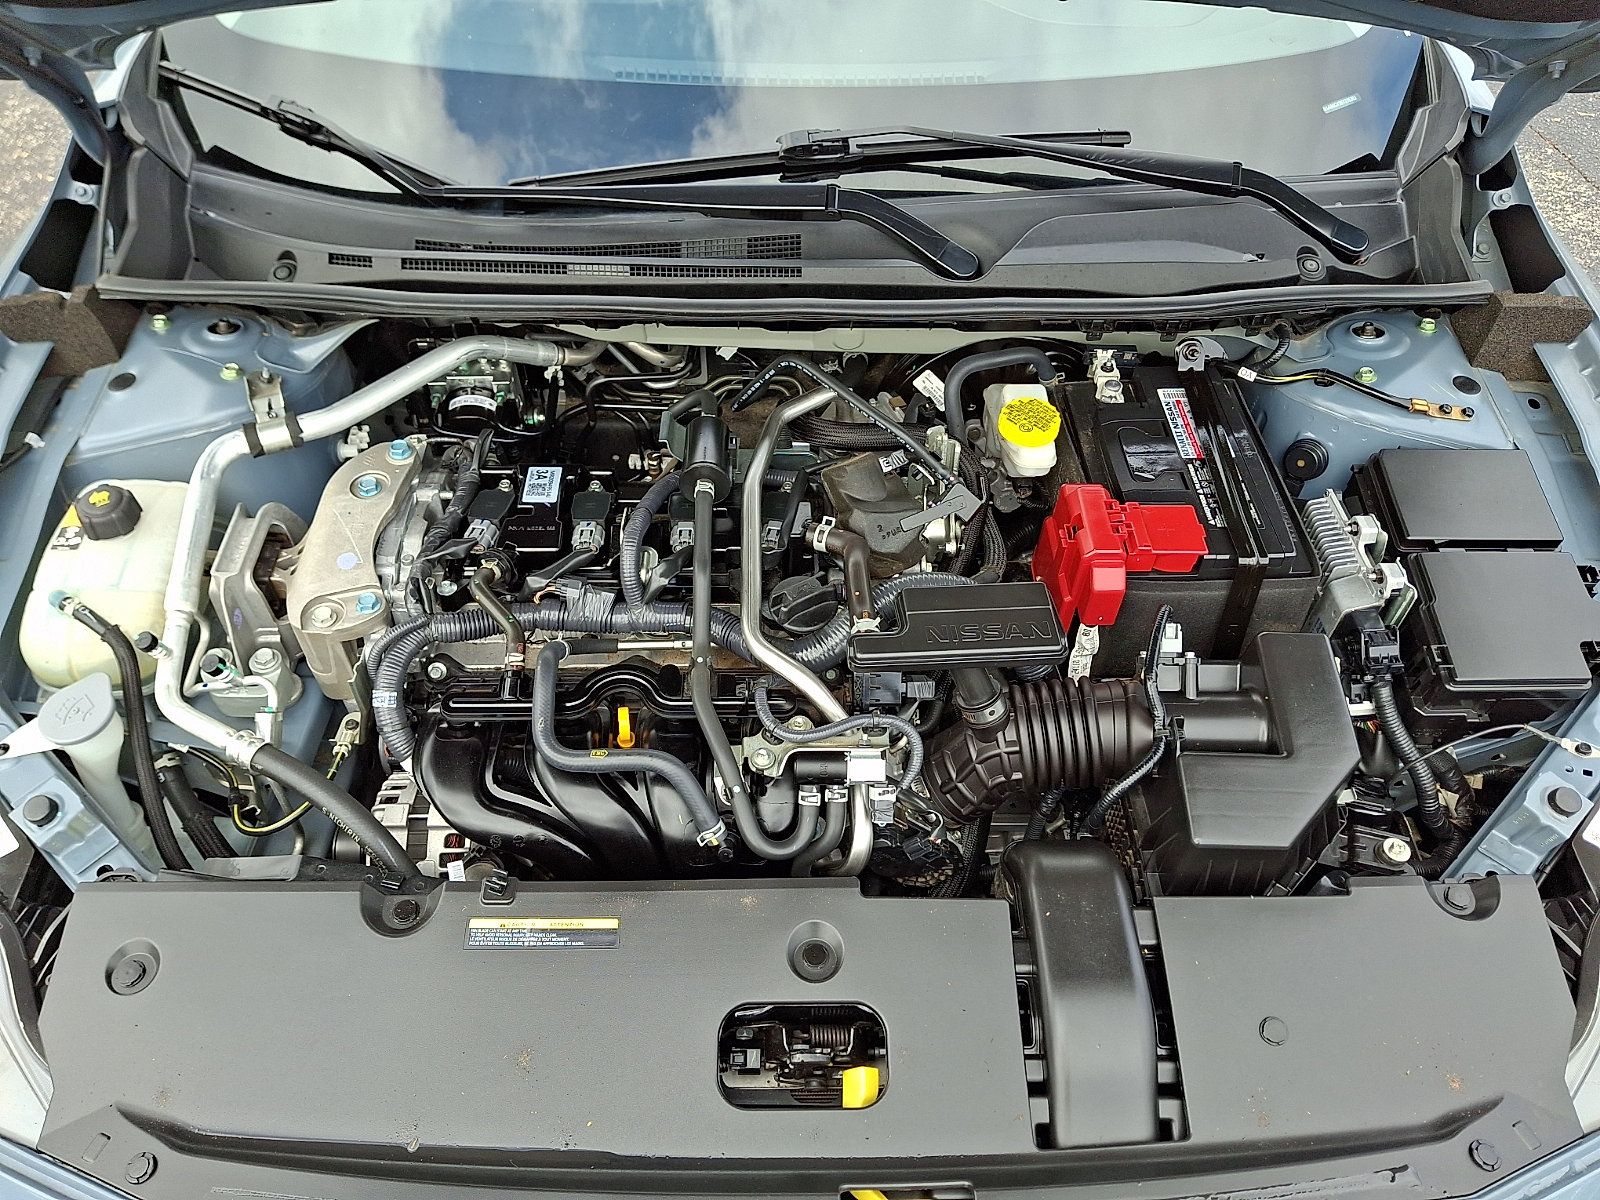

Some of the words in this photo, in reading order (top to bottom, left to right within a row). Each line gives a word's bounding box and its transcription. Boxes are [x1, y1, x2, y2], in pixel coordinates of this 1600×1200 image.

[1163, 401, 1181, 430] NISSAN
[534, 469, 549, 481] 3A
[926, 620, 1053, 644] NISSAN
